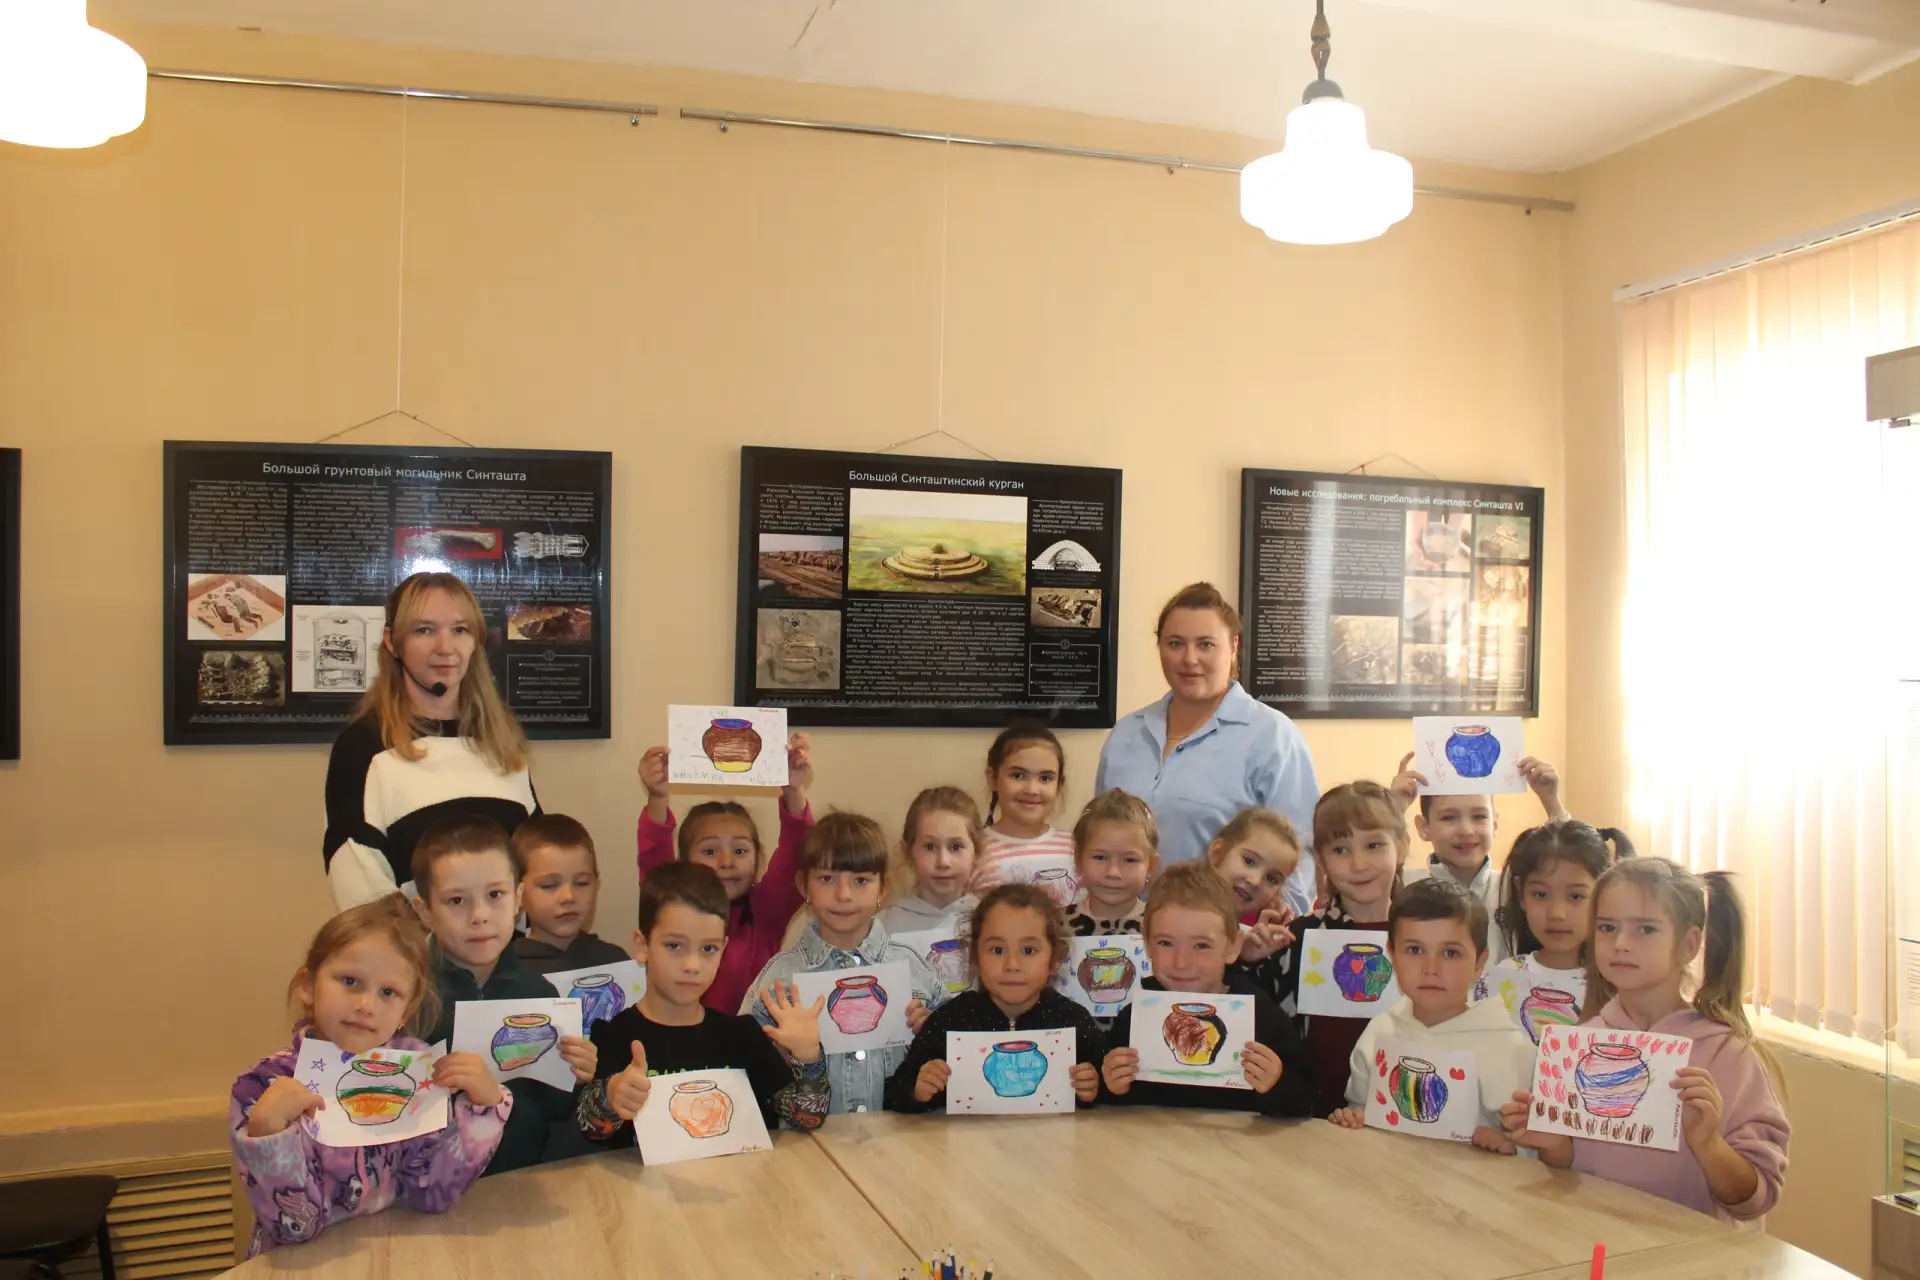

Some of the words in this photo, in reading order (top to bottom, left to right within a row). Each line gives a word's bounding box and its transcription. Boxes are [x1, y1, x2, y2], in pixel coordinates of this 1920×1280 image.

[262, 462, 320, 475] Большой
[324, 465, 392, 478] грунтовый
[396, 468, 463, 481] могильник
[466, 468, 527, 482] Синташта
[849, 470, 898, 482] Большой
[901, 473, 985, 487] Синташтинский
[988, 479, 1024, 491] курган
[1269, 485, 1300, 498] Новые
[1302, 488, 1367, 501] исследования:
[1369, 492, 1430, 506] погребальный
[1432, 496, 1472, 508] комплекс
[1473, 497, 1513, 511] Синташта
[1514, 501, 1524, 512] VI
